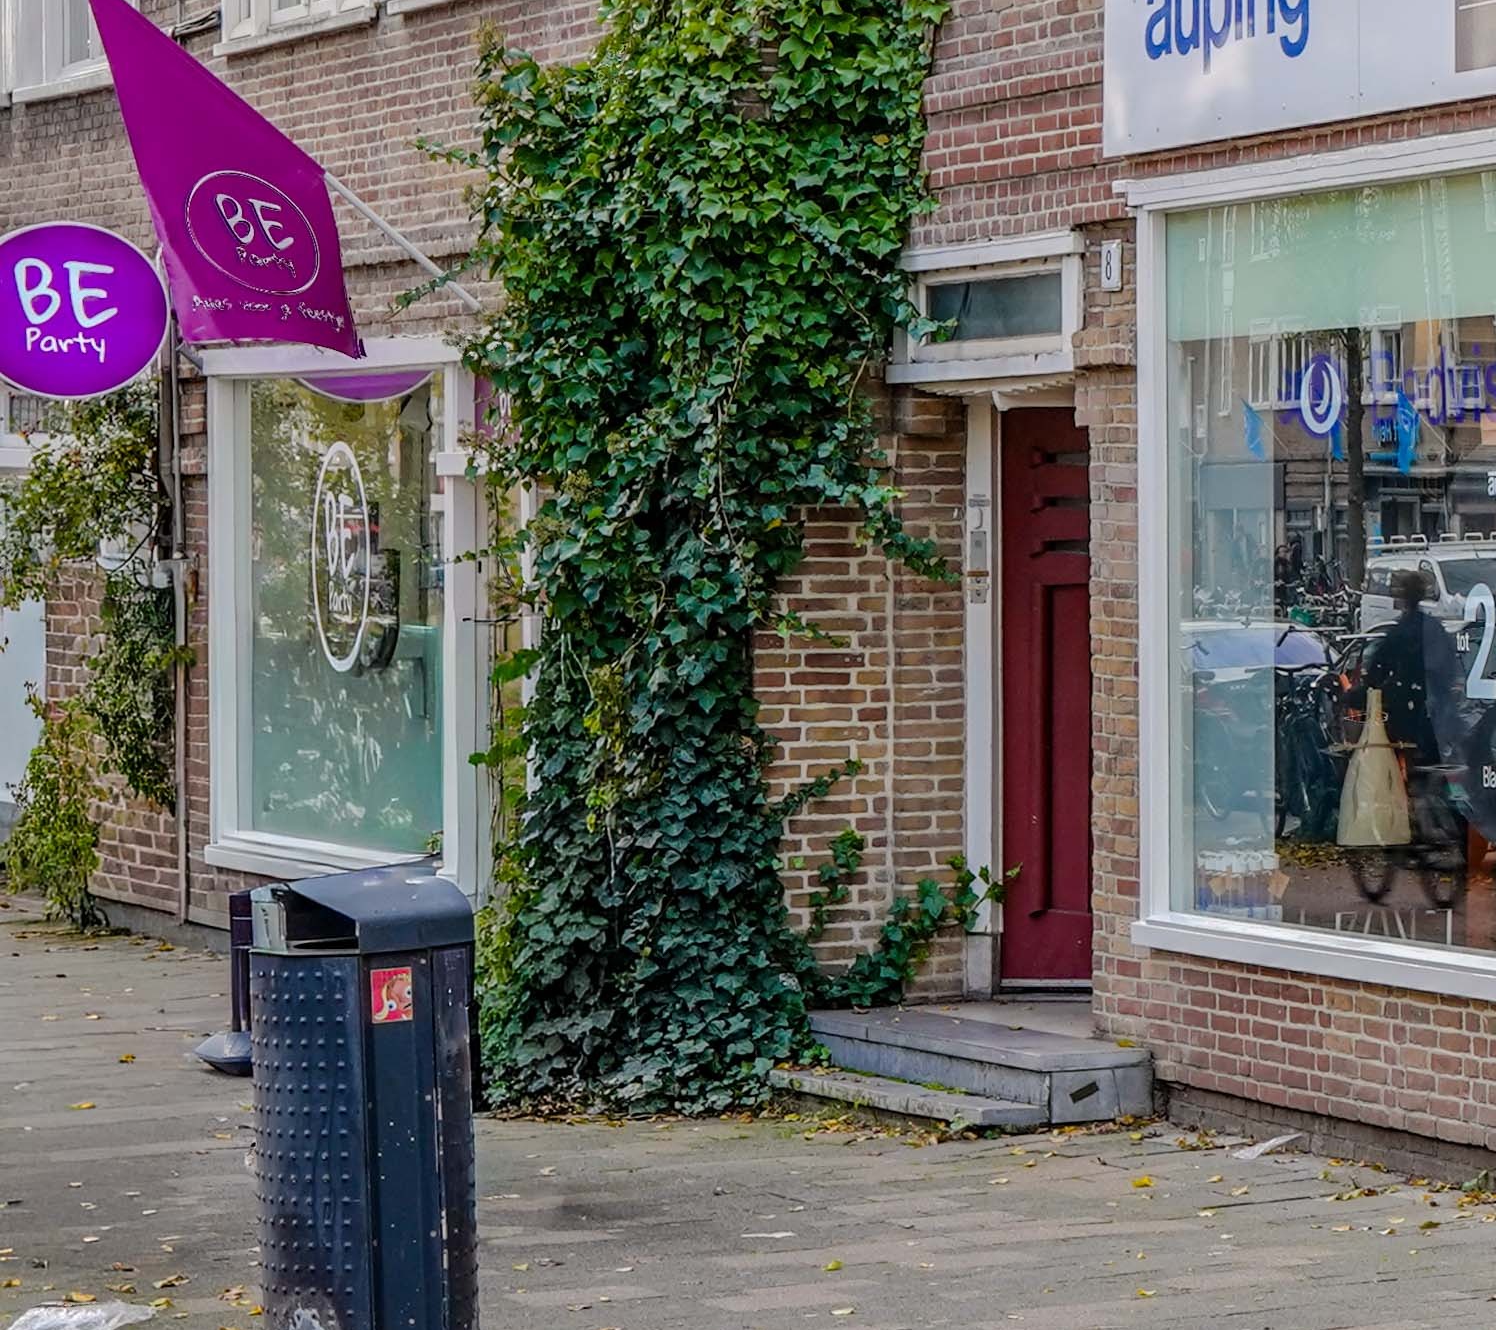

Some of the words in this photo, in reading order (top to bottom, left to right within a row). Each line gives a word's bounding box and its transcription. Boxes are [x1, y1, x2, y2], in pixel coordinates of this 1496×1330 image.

[214, 194, 295, 250] BE
[1104, 249, 1112, 281] 8
[14, 257, 118, 328] BE
[26, 327, 105, 363] Party
[1456, 633, 1470, 652] tot
